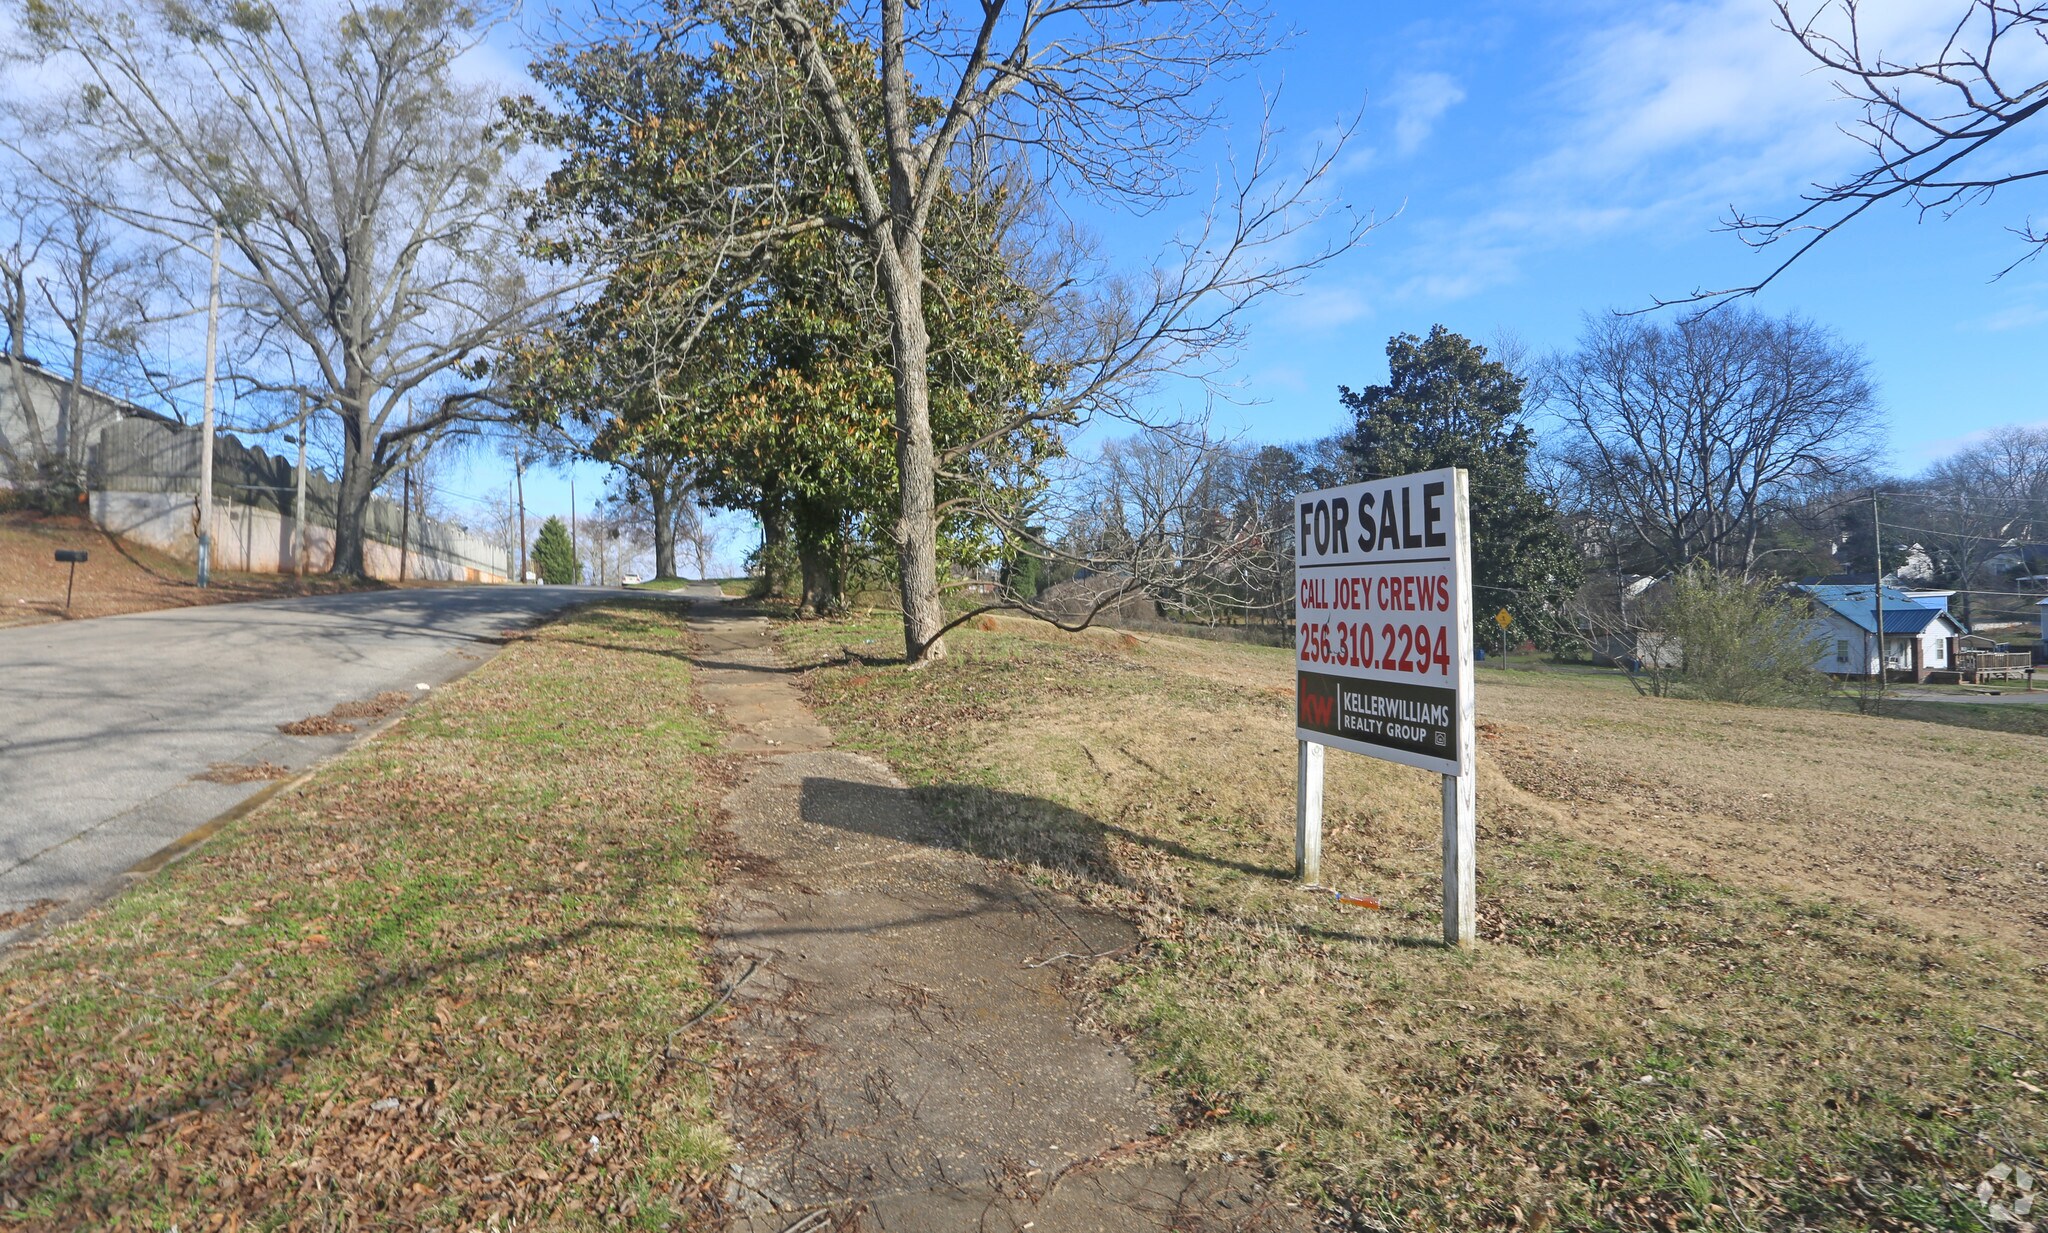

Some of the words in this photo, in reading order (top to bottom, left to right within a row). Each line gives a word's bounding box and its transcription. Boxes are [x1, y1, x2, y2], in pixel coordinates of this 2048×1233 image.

[1300, 496, 1349, 557] FOR
[1358, 481, 1446, 553] SALE
[1300, 577, 1328, 609] CALL
[1333, 577, 1373, 610] JOEY
[1377, 574, 1449, 612] CREWS
[1300, 622, 1450, 675] 256.310.2294
[1344, 715, 1383, 734] REALTY
[1386, 722, 1427, 742] GROUP
